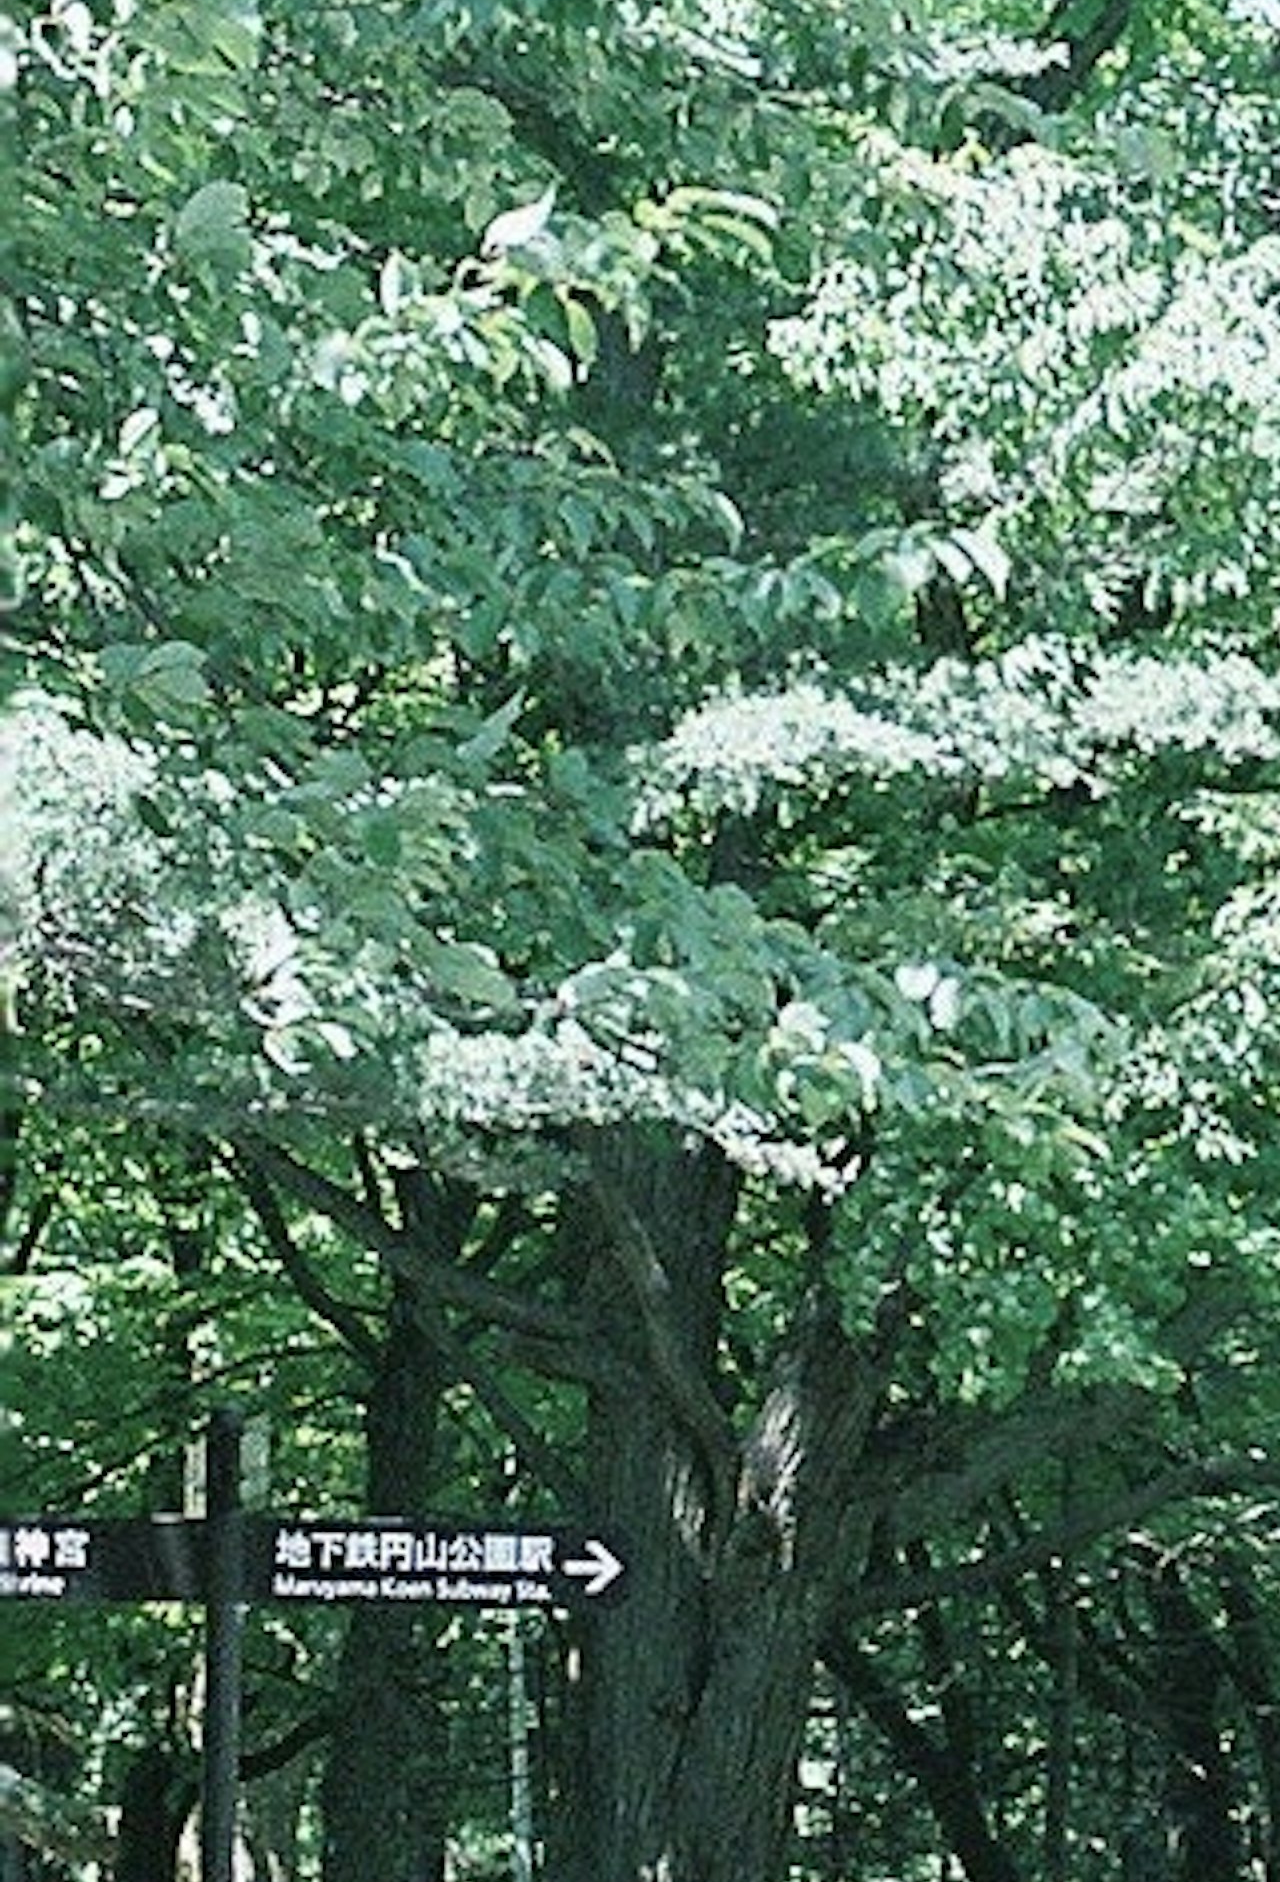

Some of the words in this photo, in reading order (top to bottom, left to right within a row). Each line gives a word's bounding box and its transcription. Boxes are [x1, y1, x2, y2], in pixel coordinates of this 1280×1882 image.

[274, 1528, 555, 1573] 地下鉄円山公園駅
[380, 1576, 434, 1600] Koen
[435, 1576, 513, 1605] Subway
